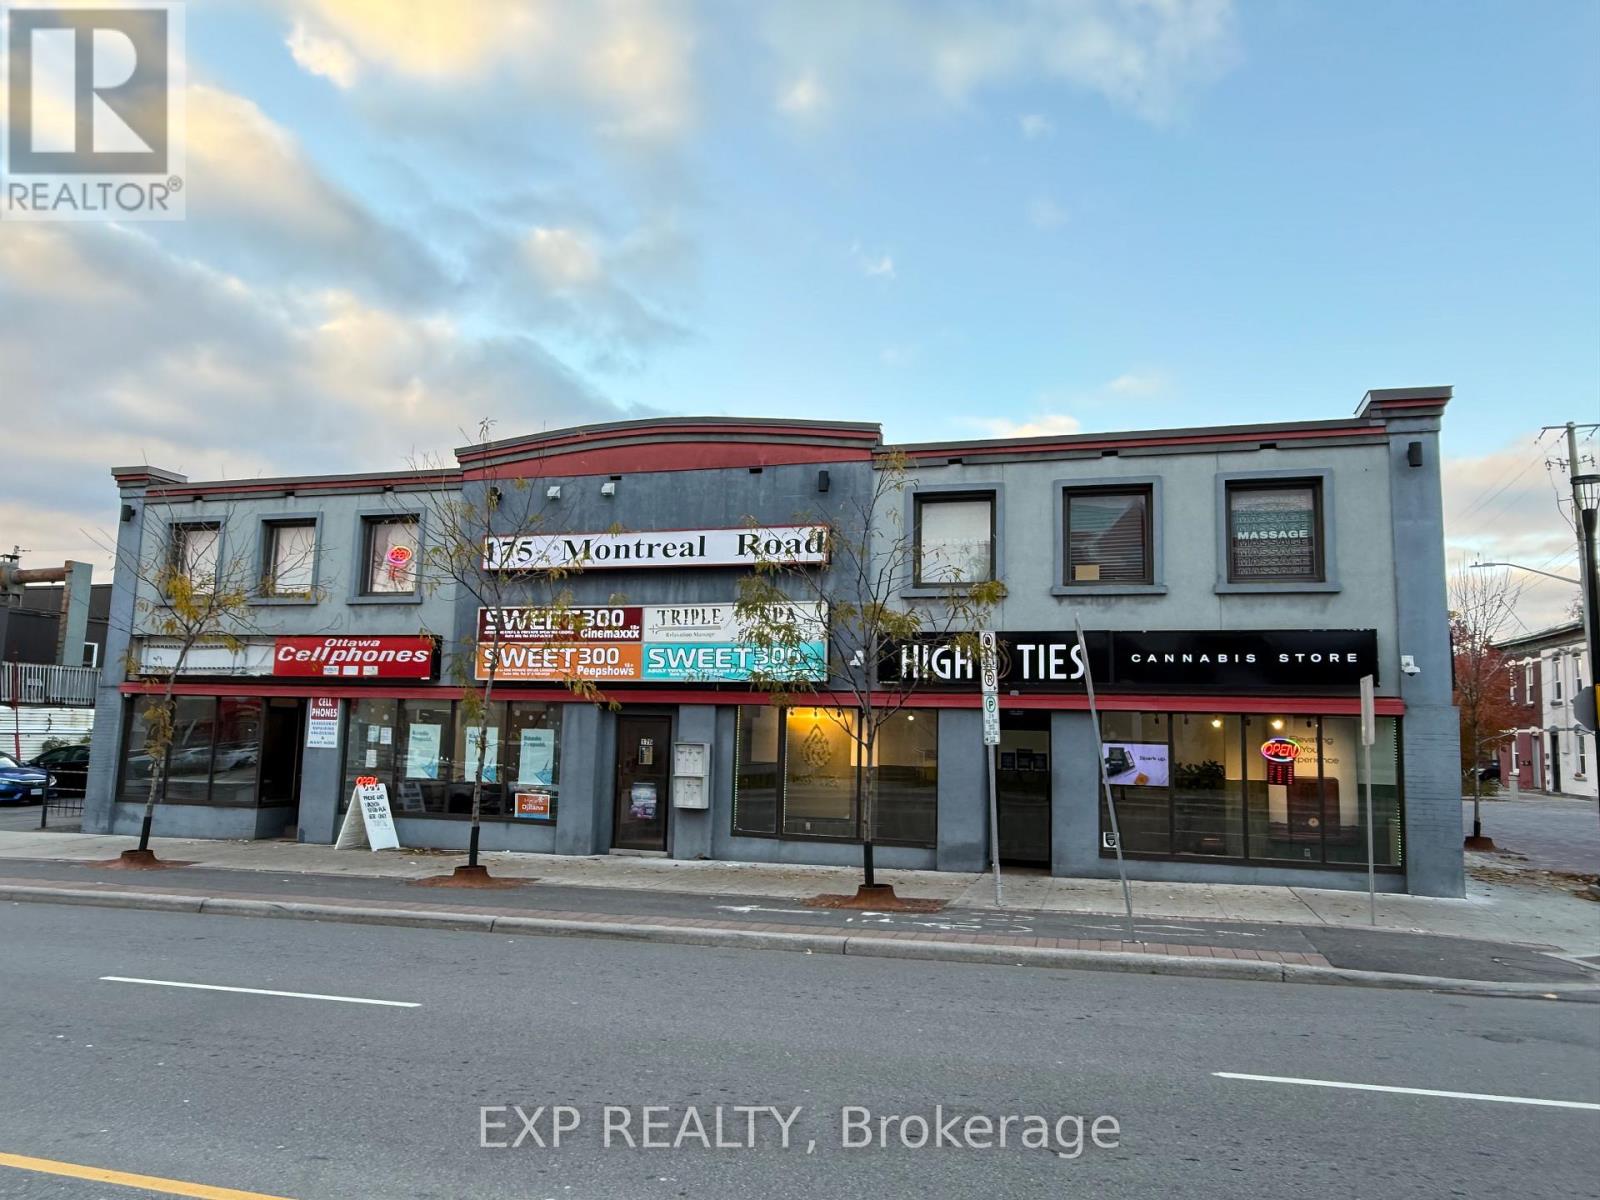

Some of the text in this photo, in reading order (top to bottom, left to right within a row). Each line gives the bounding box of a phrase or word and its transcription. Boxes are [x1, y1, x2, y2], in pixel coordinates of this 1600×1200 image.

[1237, 530, 1308, 540] MASSAGE
[562, 535, 706, 561] Montreal
[736, 531, 825, 556] Road
[485, 609, 624, 630] SWET300
[657, 608, 721, 626] TRIPLE
[580, 629, 639, 639] Cinemaxxx
[324, 638, 381, 647] Ottawa
[901, 643, 1085, 680] HIGH TIES
[1131, 653, 1358, 663] CANNABIS STORE
[577, 665, 635, 677] Peepshows
[318, 697, 332, 706] CELL
[311, 708, 337, 717] PHONES
[1264, 743, 1298, 758] OPEN
